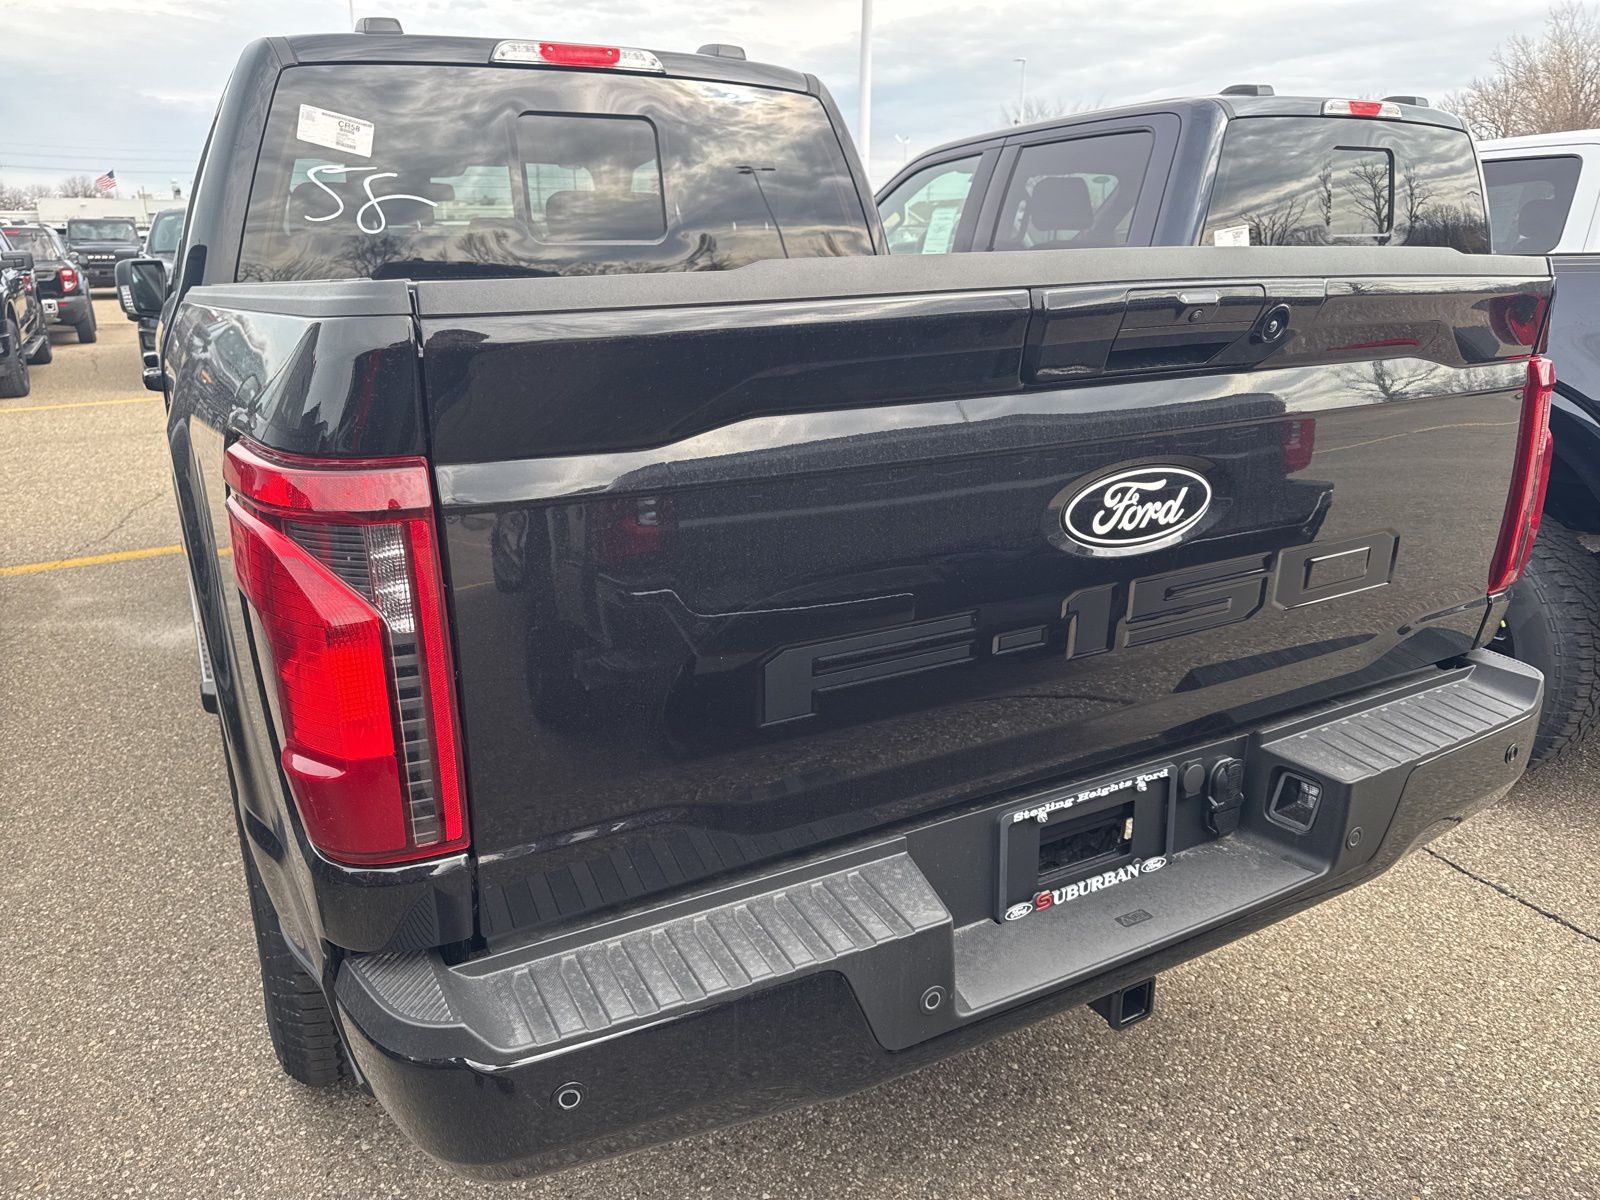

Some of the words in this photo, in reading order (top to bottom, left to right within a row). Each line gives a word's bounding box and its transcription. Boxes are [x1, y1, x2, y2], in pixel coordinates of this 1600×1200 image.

[1092, 478, 1189, 535] Ford
[757, 528, 1401, 728] F-150
[1013, 796, 1075, 823] Sterling
[1076, 779, 1133, 803] Heights
[1134, 768, 1169, 785] Ford
[1035, 863, 1141, 912] SUBURBAN
